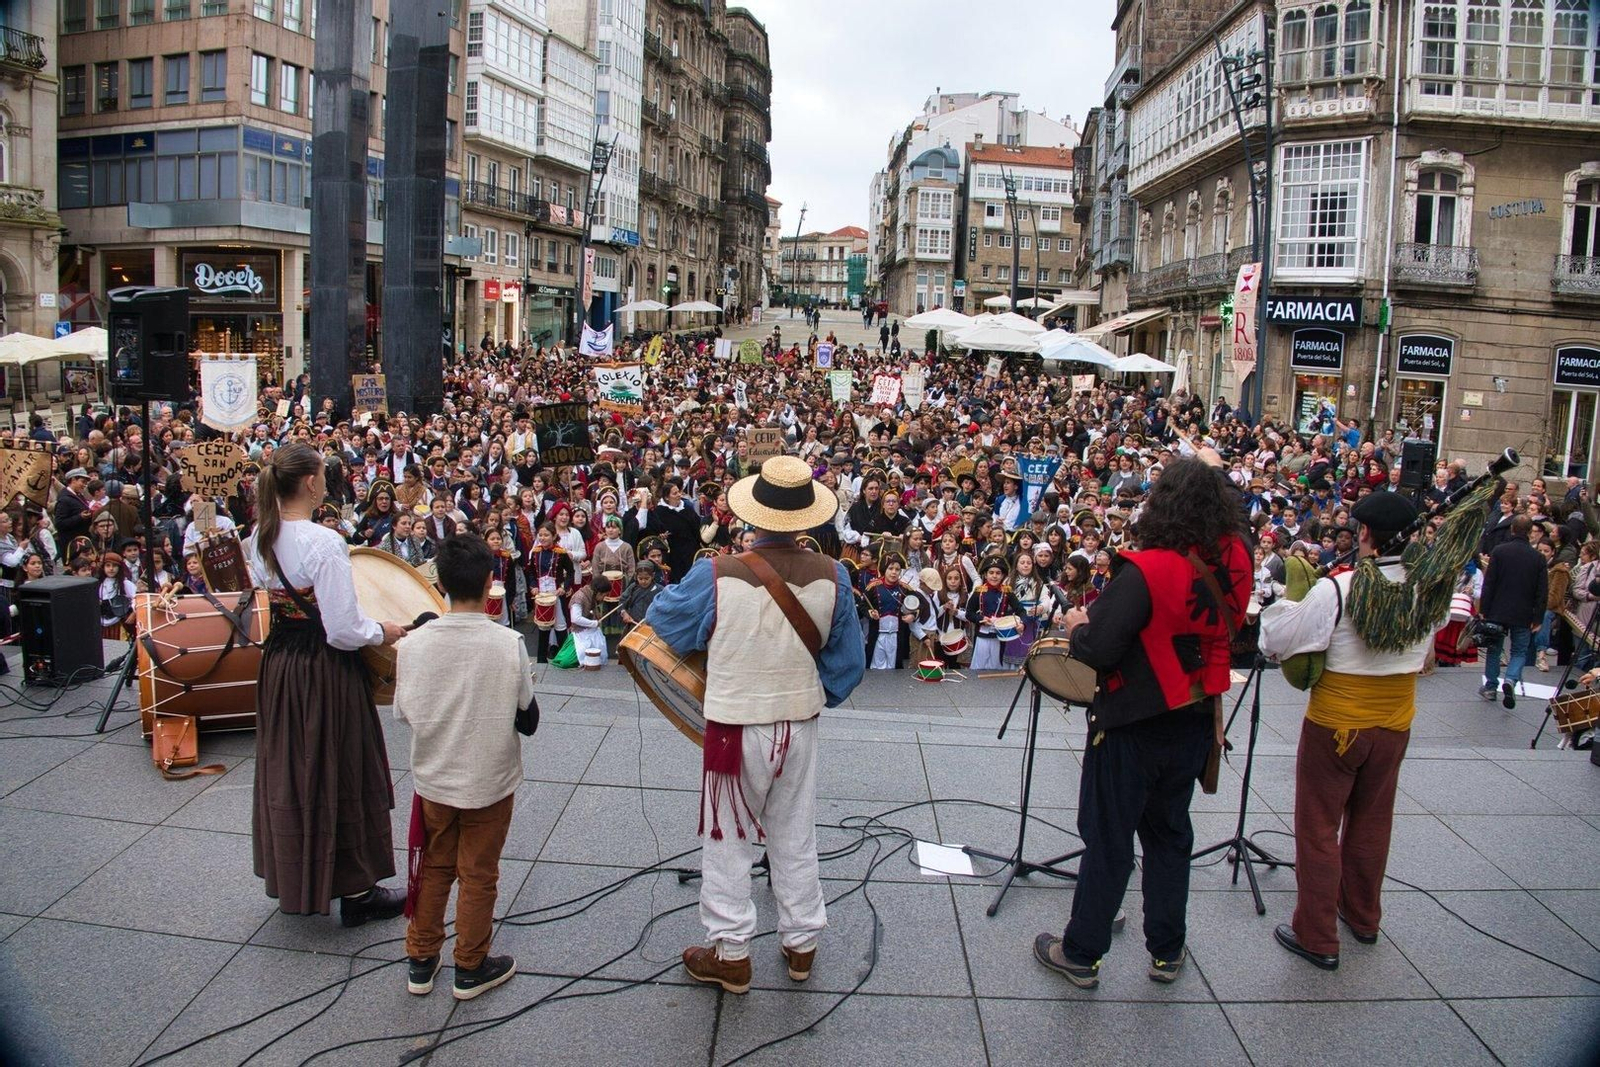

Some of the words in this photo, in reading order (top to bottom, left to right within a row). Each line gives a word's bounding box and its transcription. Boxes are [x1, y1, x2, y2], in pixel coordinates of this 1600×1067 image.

[1488, 199, 1545, 220] COSTURA
[1265, 301, 1355, 322] FARMACIA
[1234, 311, 1251, 345] R
[1295, 340, 1340, 352] FARMACIA
[1402, 345, 1449, 358] FARMACIA
[1314, 353, 1322, 361] del
[1322, 354, 1332, 362] Sol,
[1431, 359, 1441, 367] Sol,
[598, 370, 642, 387] COLEXIO
[755, 432, 776, 443] CEIP
[197, 443, 233, 457] CEIP
[204, 459, 226, 468] SAN
[1028, 464, 1048, 474] CEI
[181, 457, 243, 488] SALVADOR
[194, 486, 228, 497] TEIS
[196, 504, 212, 528] 4
[208, 546, 229, 558] CEIP
